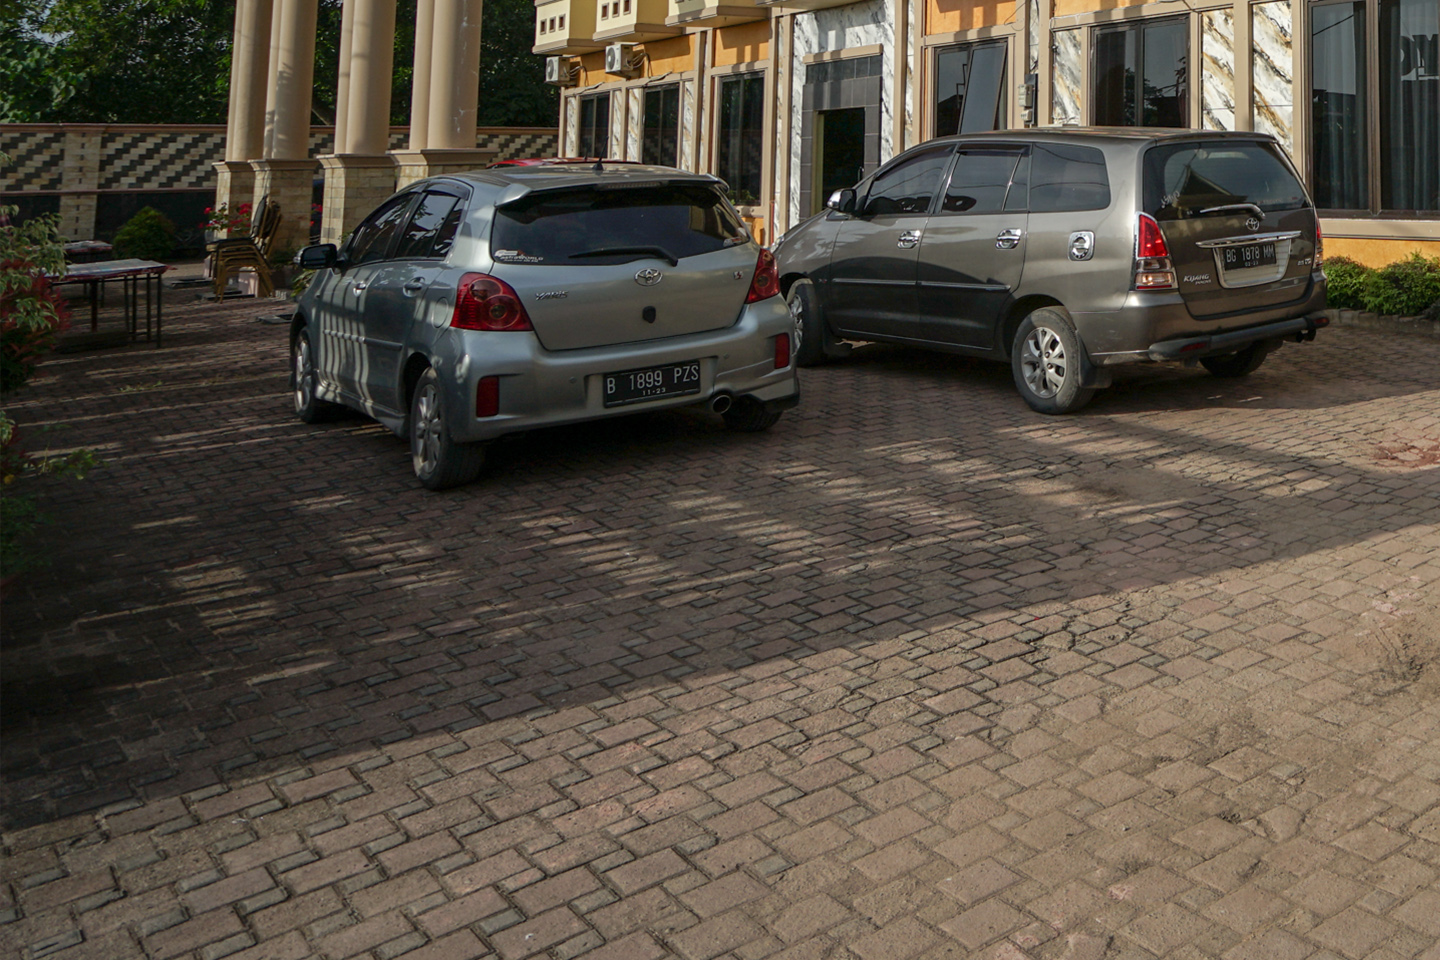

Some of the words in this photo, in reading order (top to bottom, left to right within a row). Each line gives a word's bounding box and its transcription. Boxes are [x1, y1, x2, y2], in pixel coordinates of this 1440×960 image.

[1225, 249, 1237, 263] BG
[1241, 246, 1260, 261] 1878
[1263, 244, 1275, 258] MM
[606, 377, 616, 394] B
[629, 370, 663, 390] 1899
[673, 365, 699, 384] PZS
